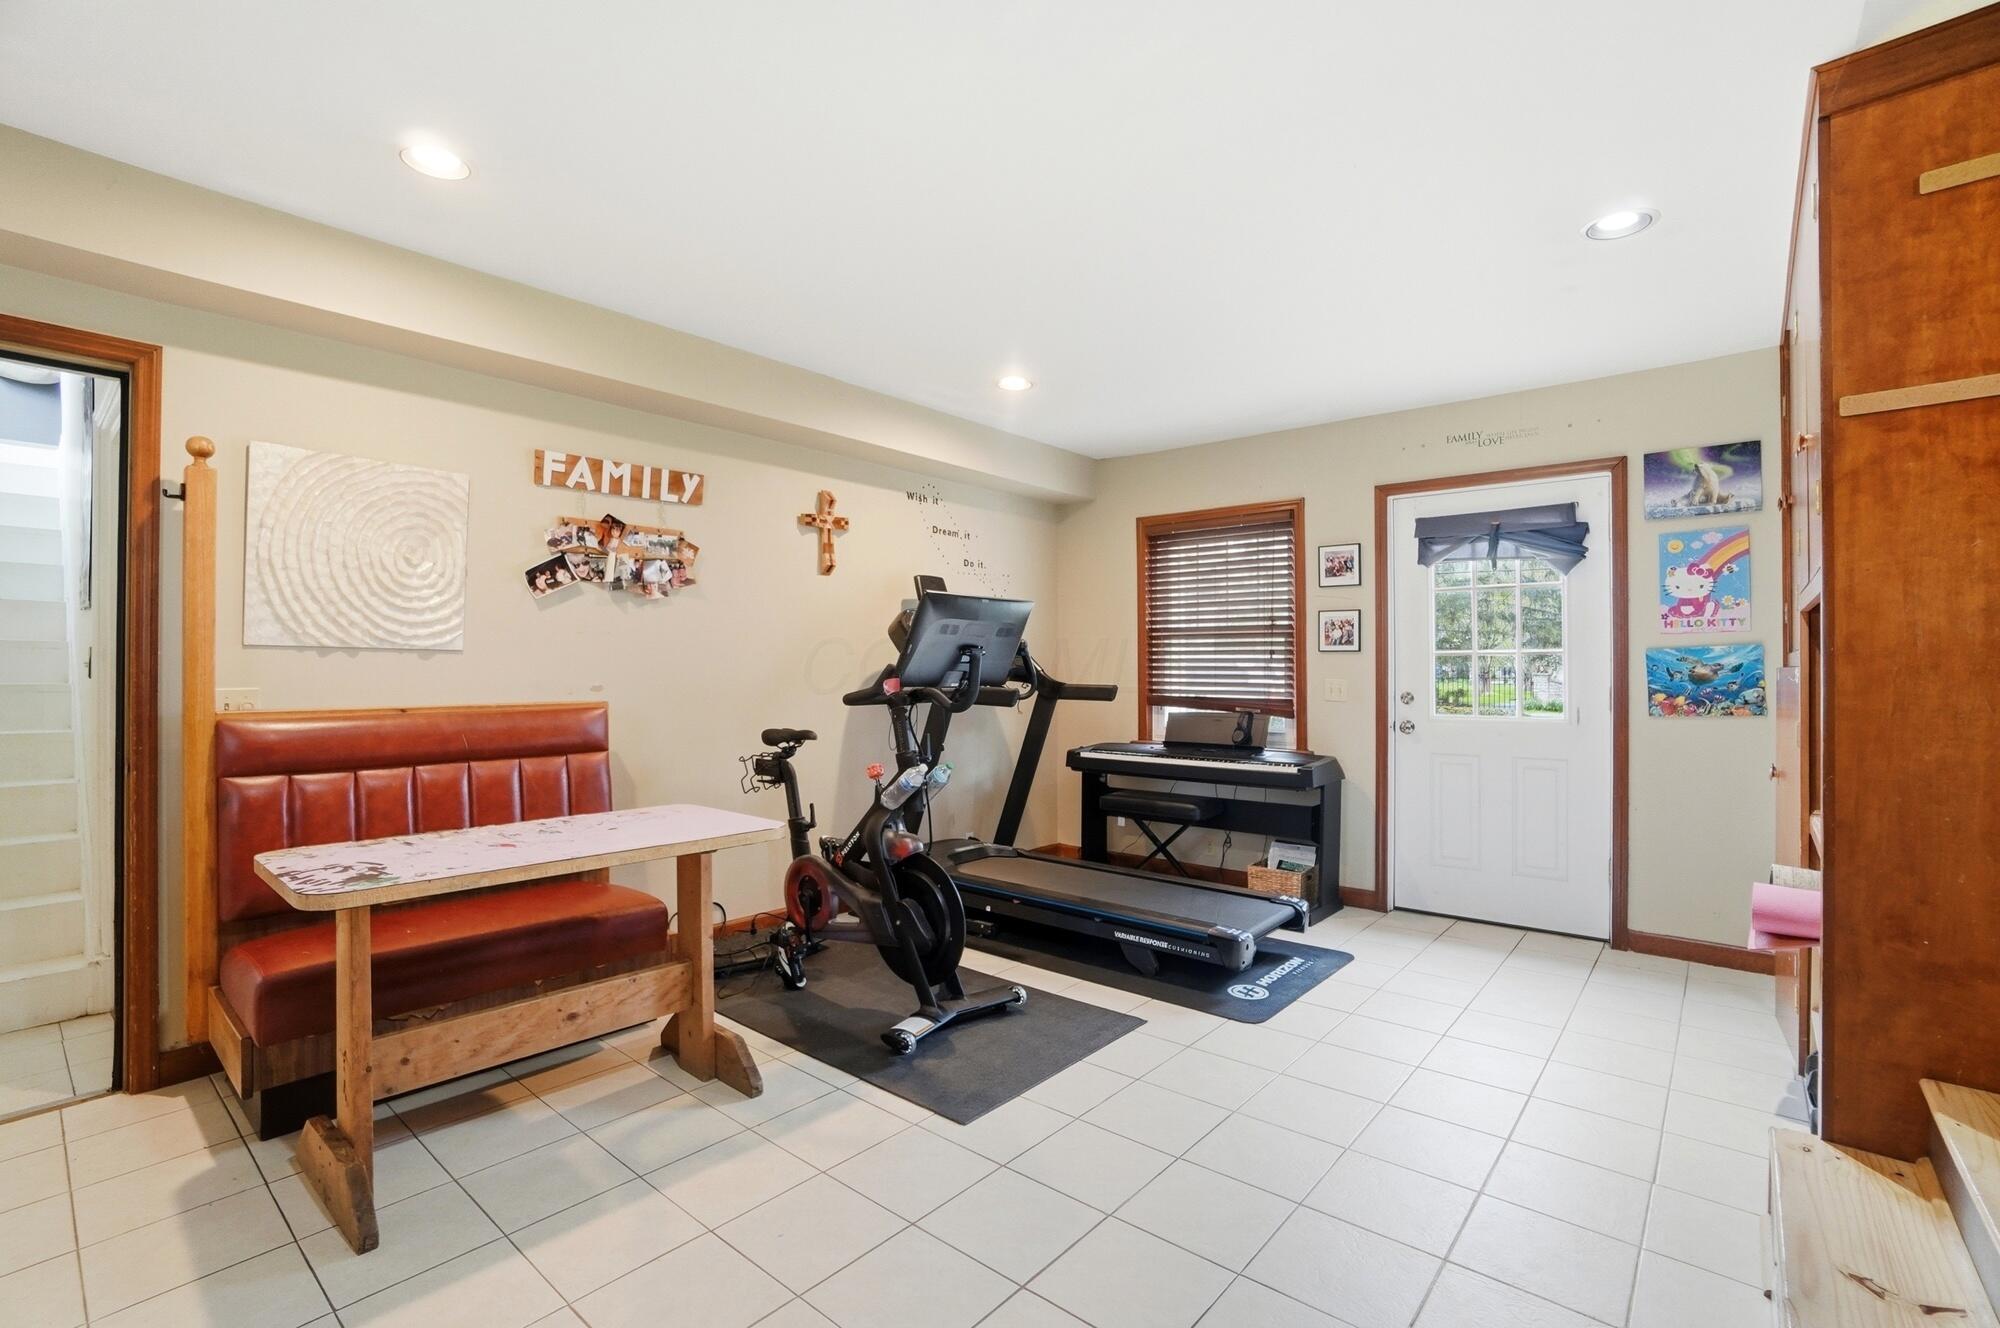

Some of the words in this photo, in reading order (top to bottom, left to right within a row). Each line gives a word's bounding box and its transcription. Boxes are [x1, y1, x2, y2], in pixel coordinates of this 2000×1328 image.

[1446, 431, 1482, 444] FAMILY
[1478, 436, 1504, 448] LOVE
[542, 450, 701, 504] FAMILY
[906, 490, 928, 503] Wish
[963, 559, 974, 568] Do
[1664, 619, 1704, 629] HELLO
[1707, 618, 1746, 627] KITTY
[1255, 956, 1305, 987] HORIZON
